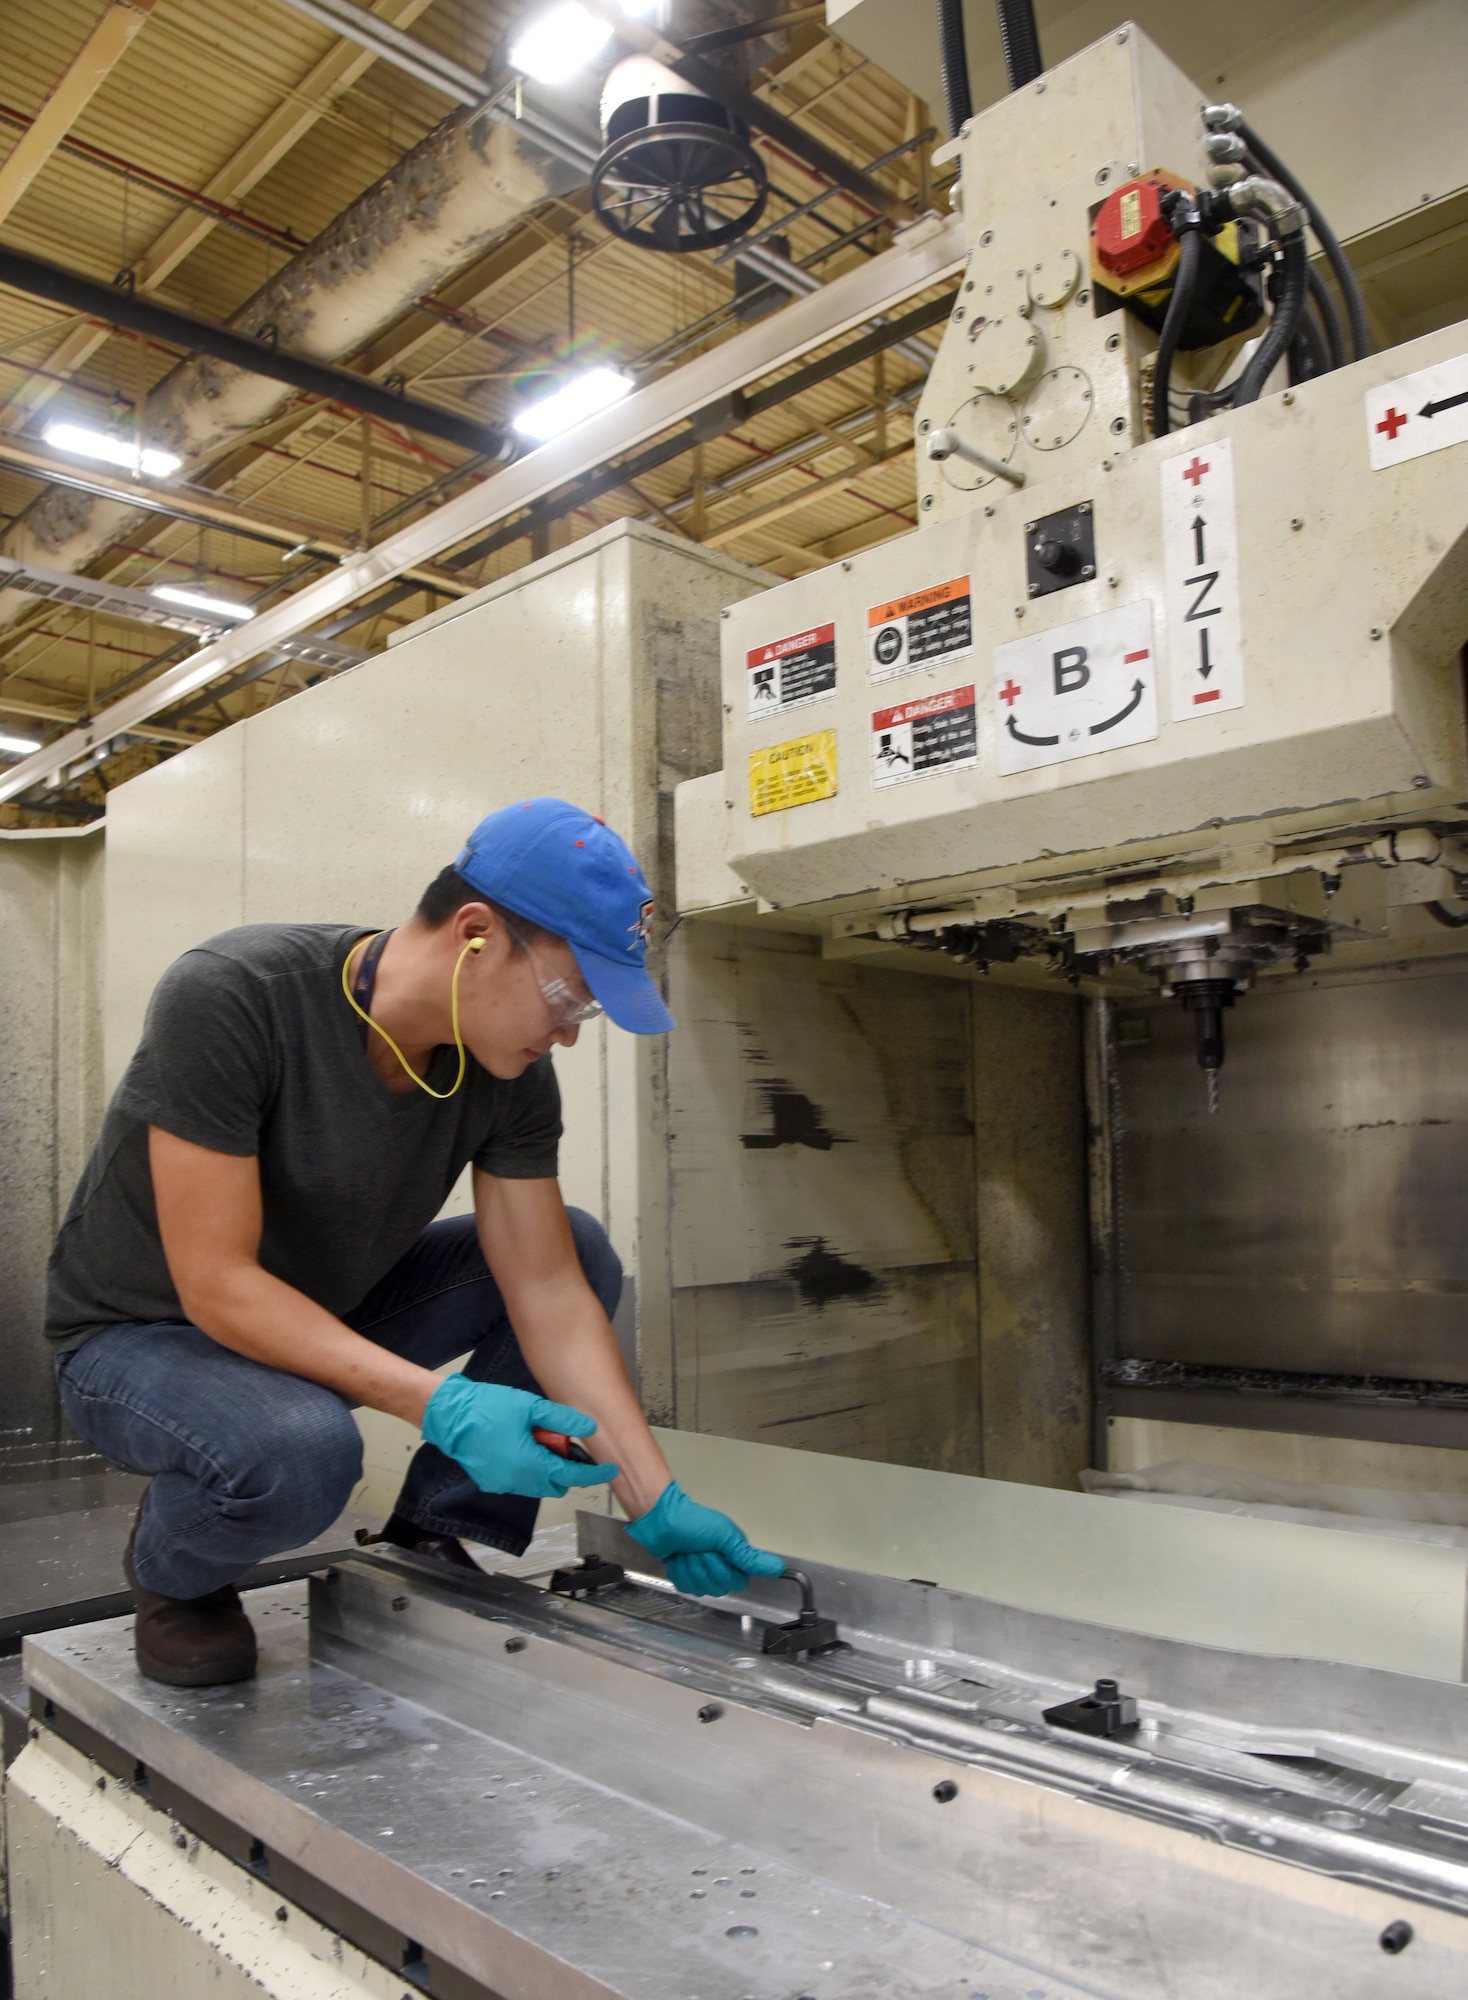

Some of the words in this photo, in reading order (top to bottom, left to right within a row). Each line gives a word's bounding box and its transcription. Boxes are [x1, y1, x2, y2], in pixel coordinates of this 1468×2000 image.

[897, 586, 952, 613] WARNING
[1184, 571, 1222, 622] Z
[775, 632, 819, 656] DANGER
[1052, 645, 1090, 695] B
[904, 695, 956, 719] DANGER
[768, 743, 814, 764] CAUTION
